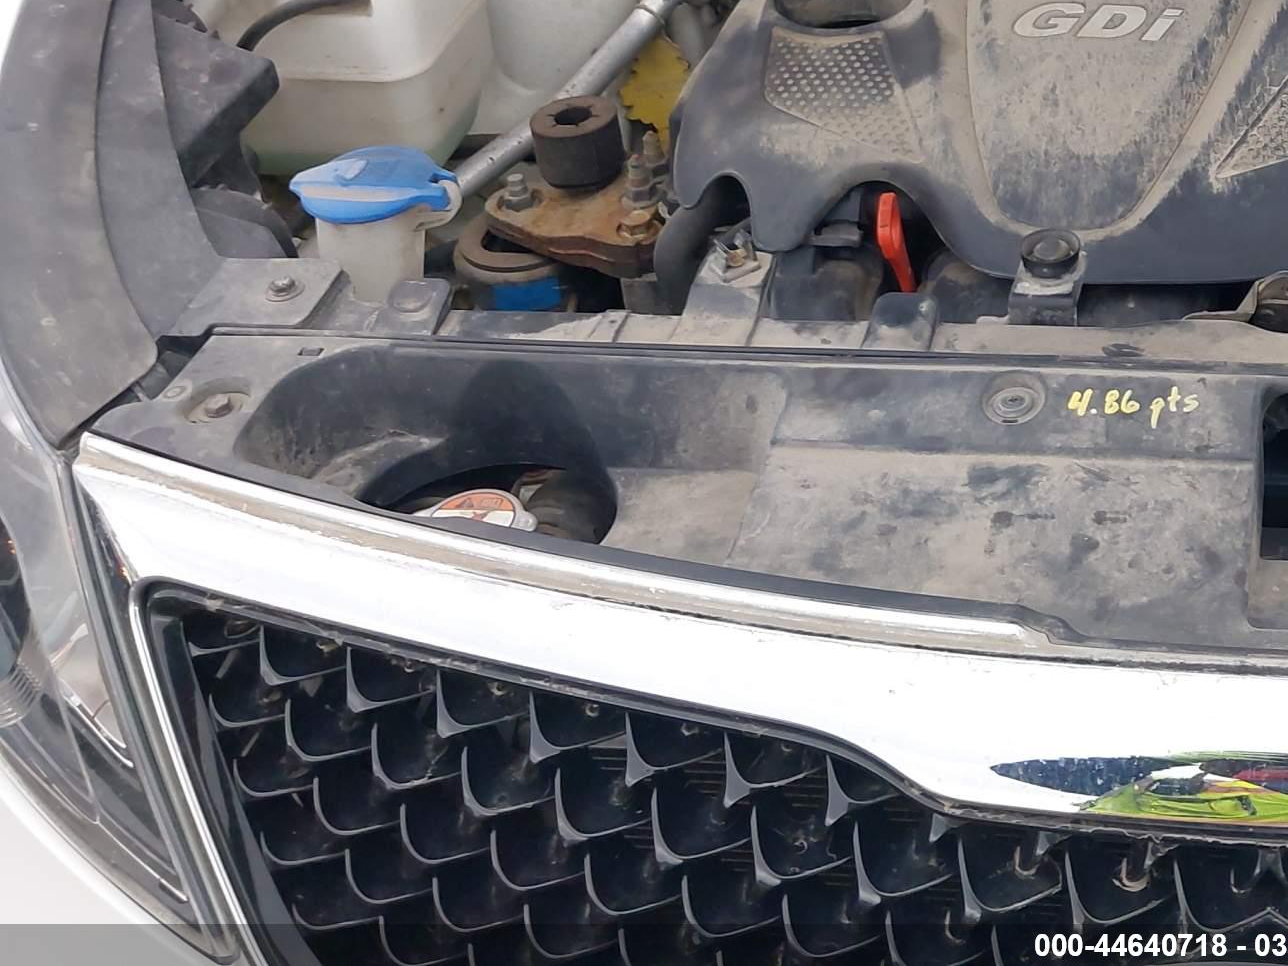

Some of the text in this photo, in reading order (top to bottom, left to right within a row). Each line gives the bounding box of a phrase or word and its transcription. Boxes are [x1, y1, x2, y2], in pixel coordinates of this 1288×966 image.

[1012, 2, 1185, 41] GDi
[1067, 386, 1200, 430] 4.86 pts
